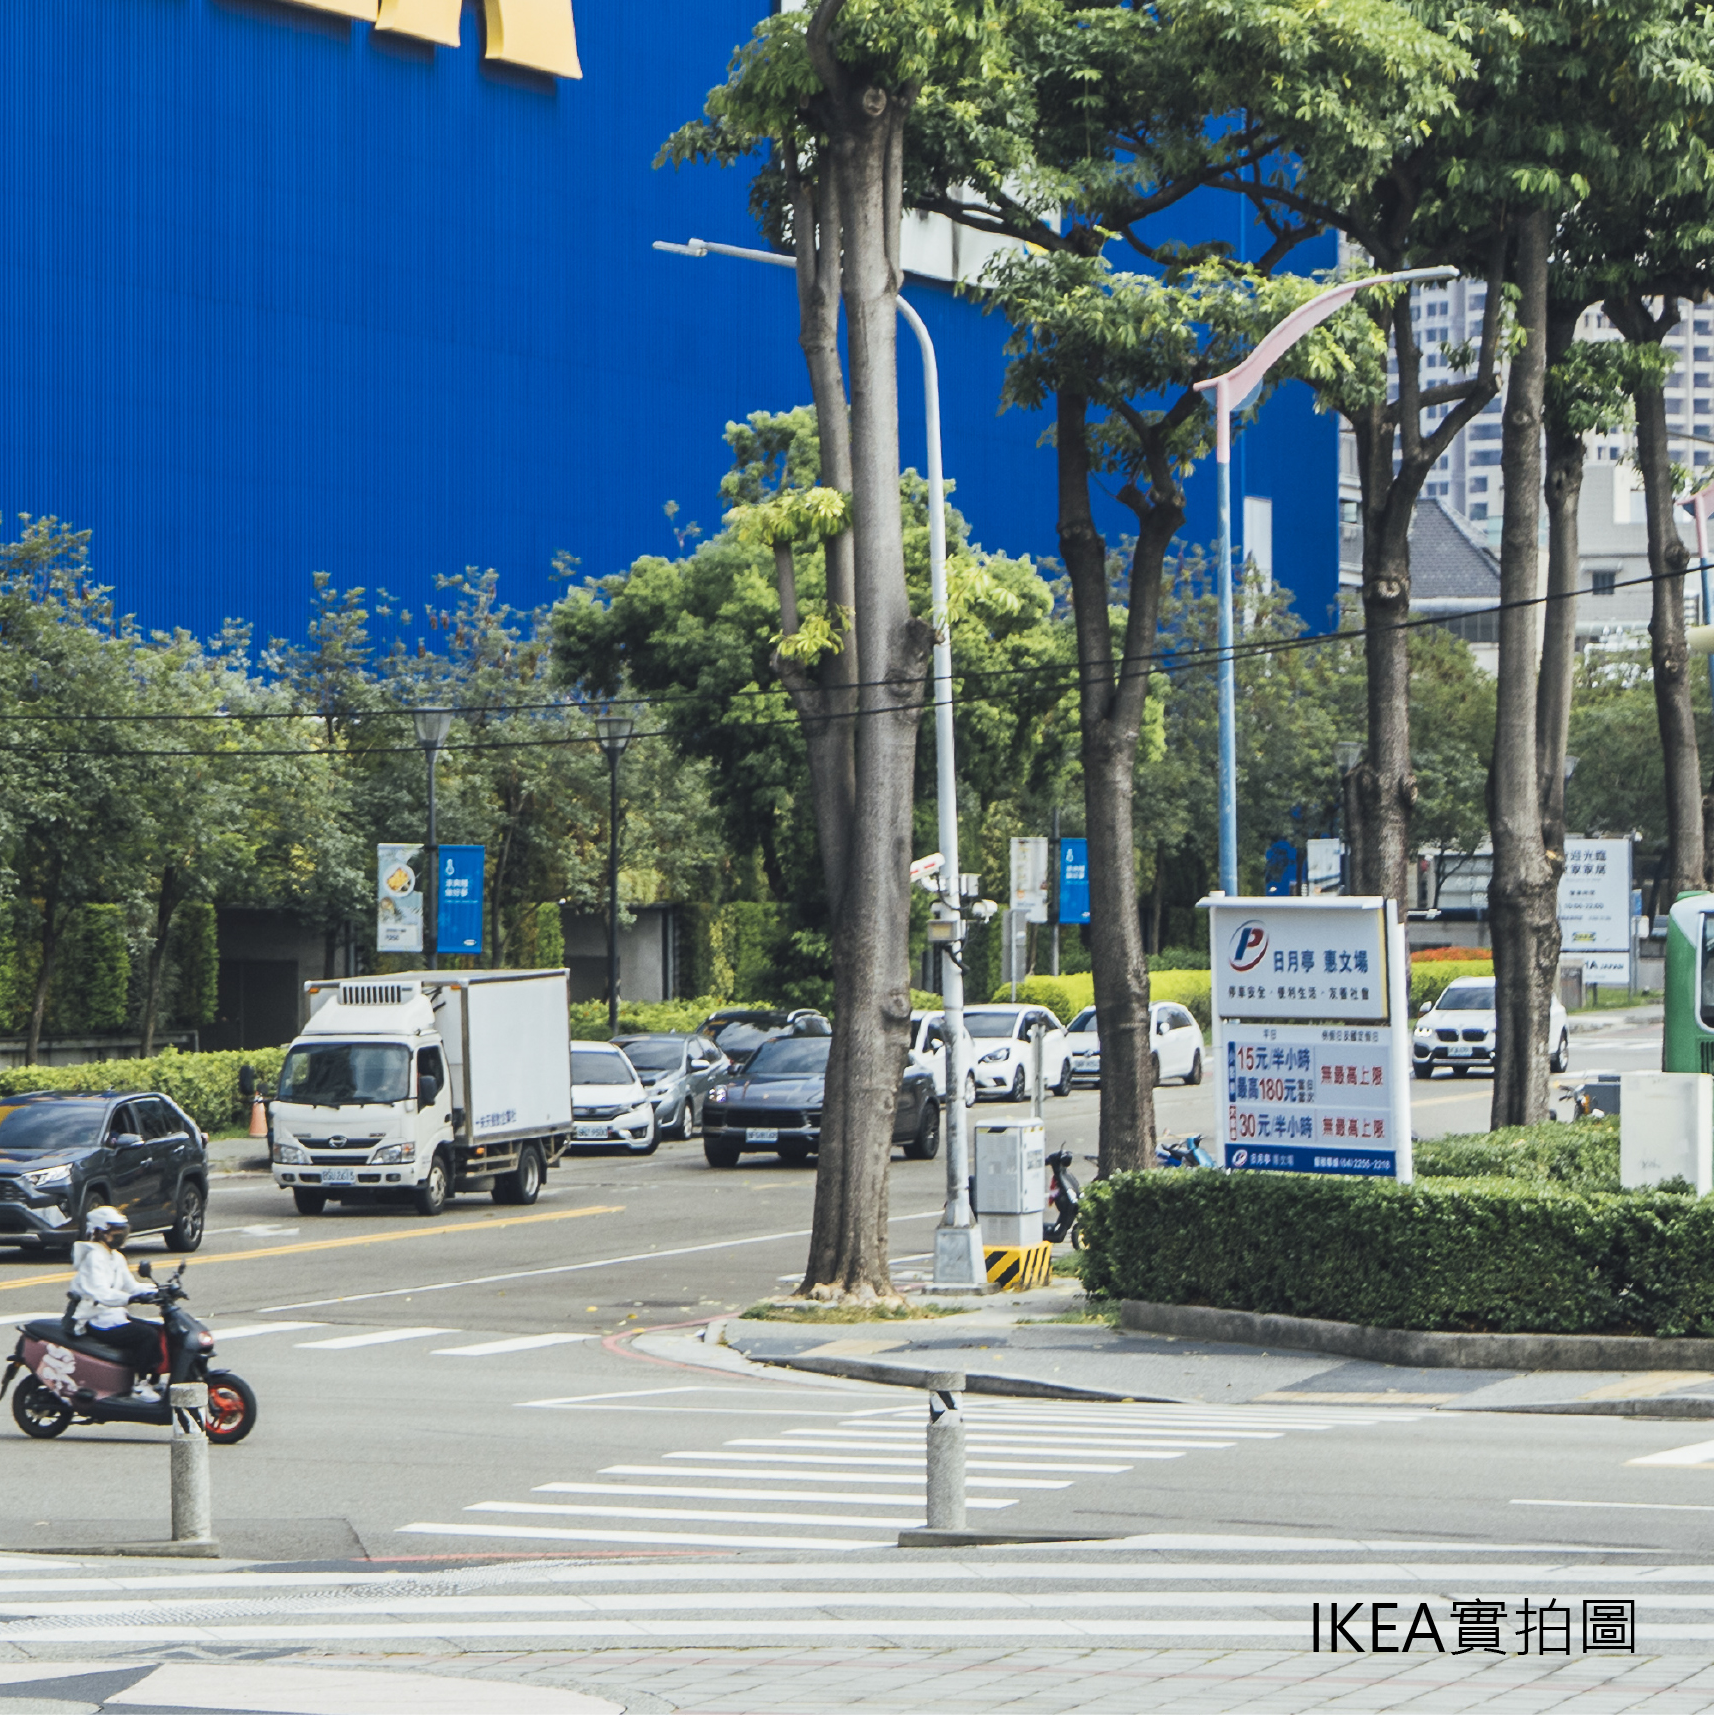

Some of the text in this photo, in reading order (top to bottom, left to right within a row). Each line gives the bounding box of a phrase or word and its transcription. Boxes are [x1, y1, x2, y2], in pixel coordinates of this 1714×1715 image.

[1273, 950, 1369, 974] 日月亭 惠文場
[1321, 1065, 1383, 1085] 無最高上限
[1323, 1118, 1385, 1138] 無最高上限
